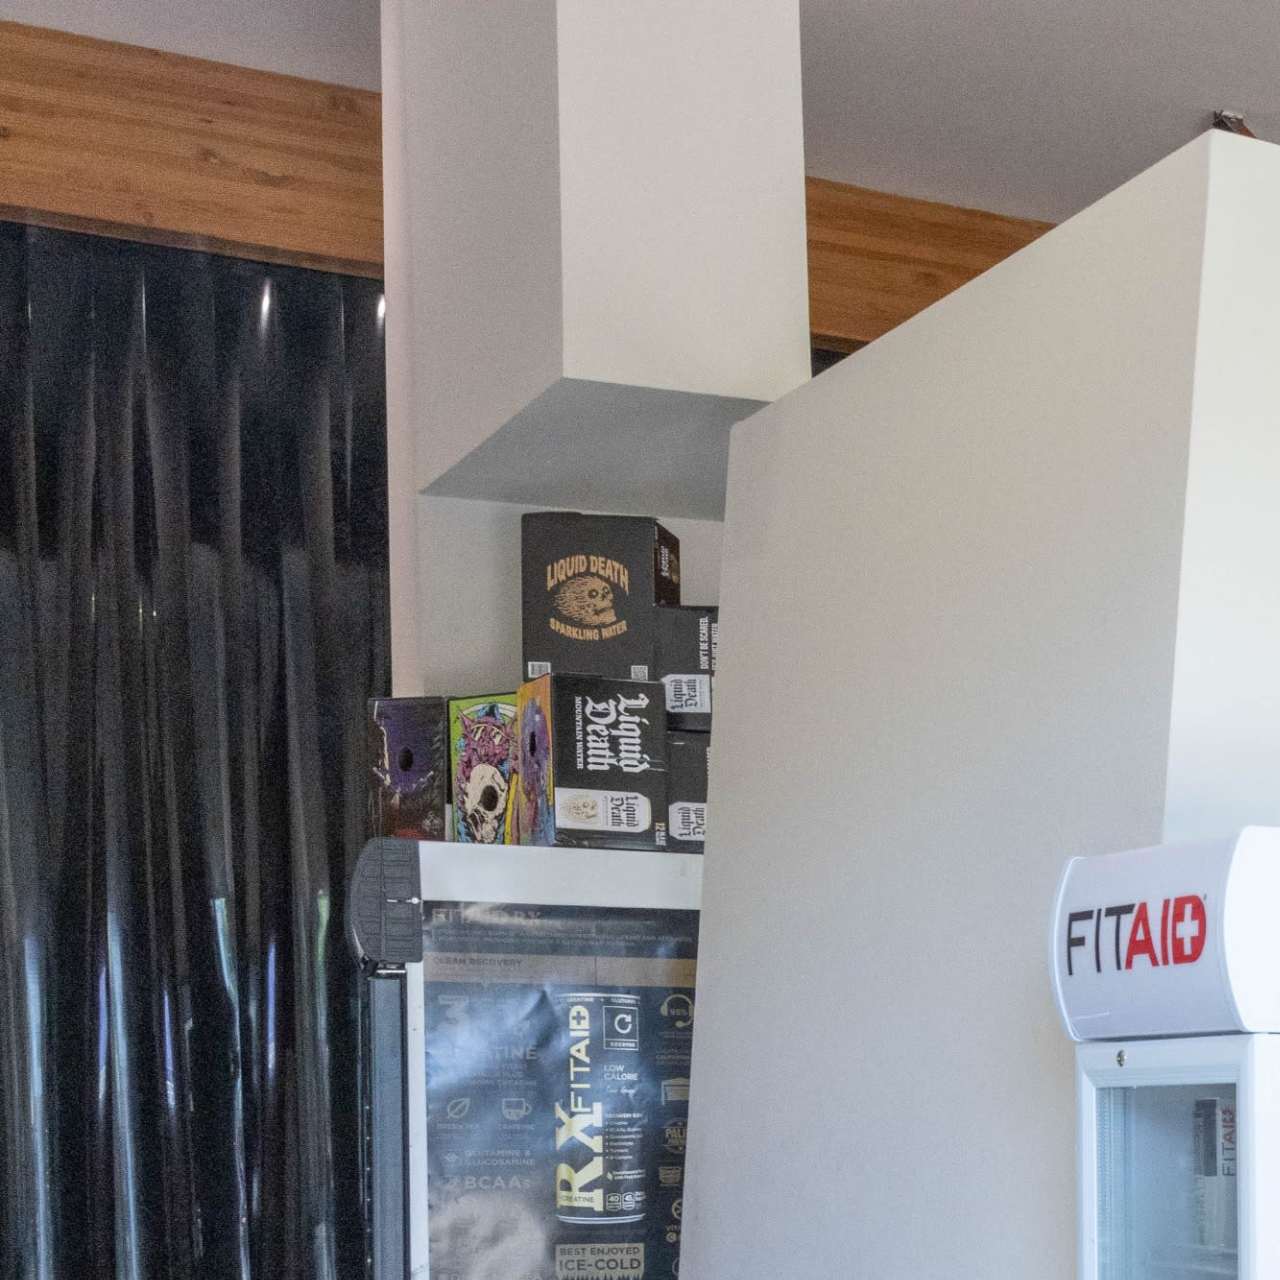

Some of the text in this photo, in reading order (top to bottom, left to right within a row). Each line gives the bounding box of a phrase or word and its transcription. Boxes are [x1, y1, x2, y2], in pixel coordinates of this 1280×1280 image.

[547, 555, 588, 592] LIQUID
[590, 556, 630, 596] DEATH
[550, 618, 628, 641] SPARKLING WATER
[671, 679, 687, 709] Liquid
[684, 679, 698, 708] Death
[575, 696, 584, 769] MOUNTAIN WATER
[584, 695, 620, 772] Death
[609, 693, 650, 773] Liquid
[610, 797, 625, 827] Death
[626, 796, 639, 828] Liquid
[678, 807, 691, 837] Liquid
[1066, 894, 1207, 976] FITAID
[568, 1005, 591, 1112] FITAID
[603, 1064, 625, 1072] LOW
[555, 1101, 604, 1212] RX
[464, 1176, 531, 1190] BCAAs
[559, 1247, 640, 1256] BEST ENJOYED
[559, 1258, 641, 1271] ICE-COLD
